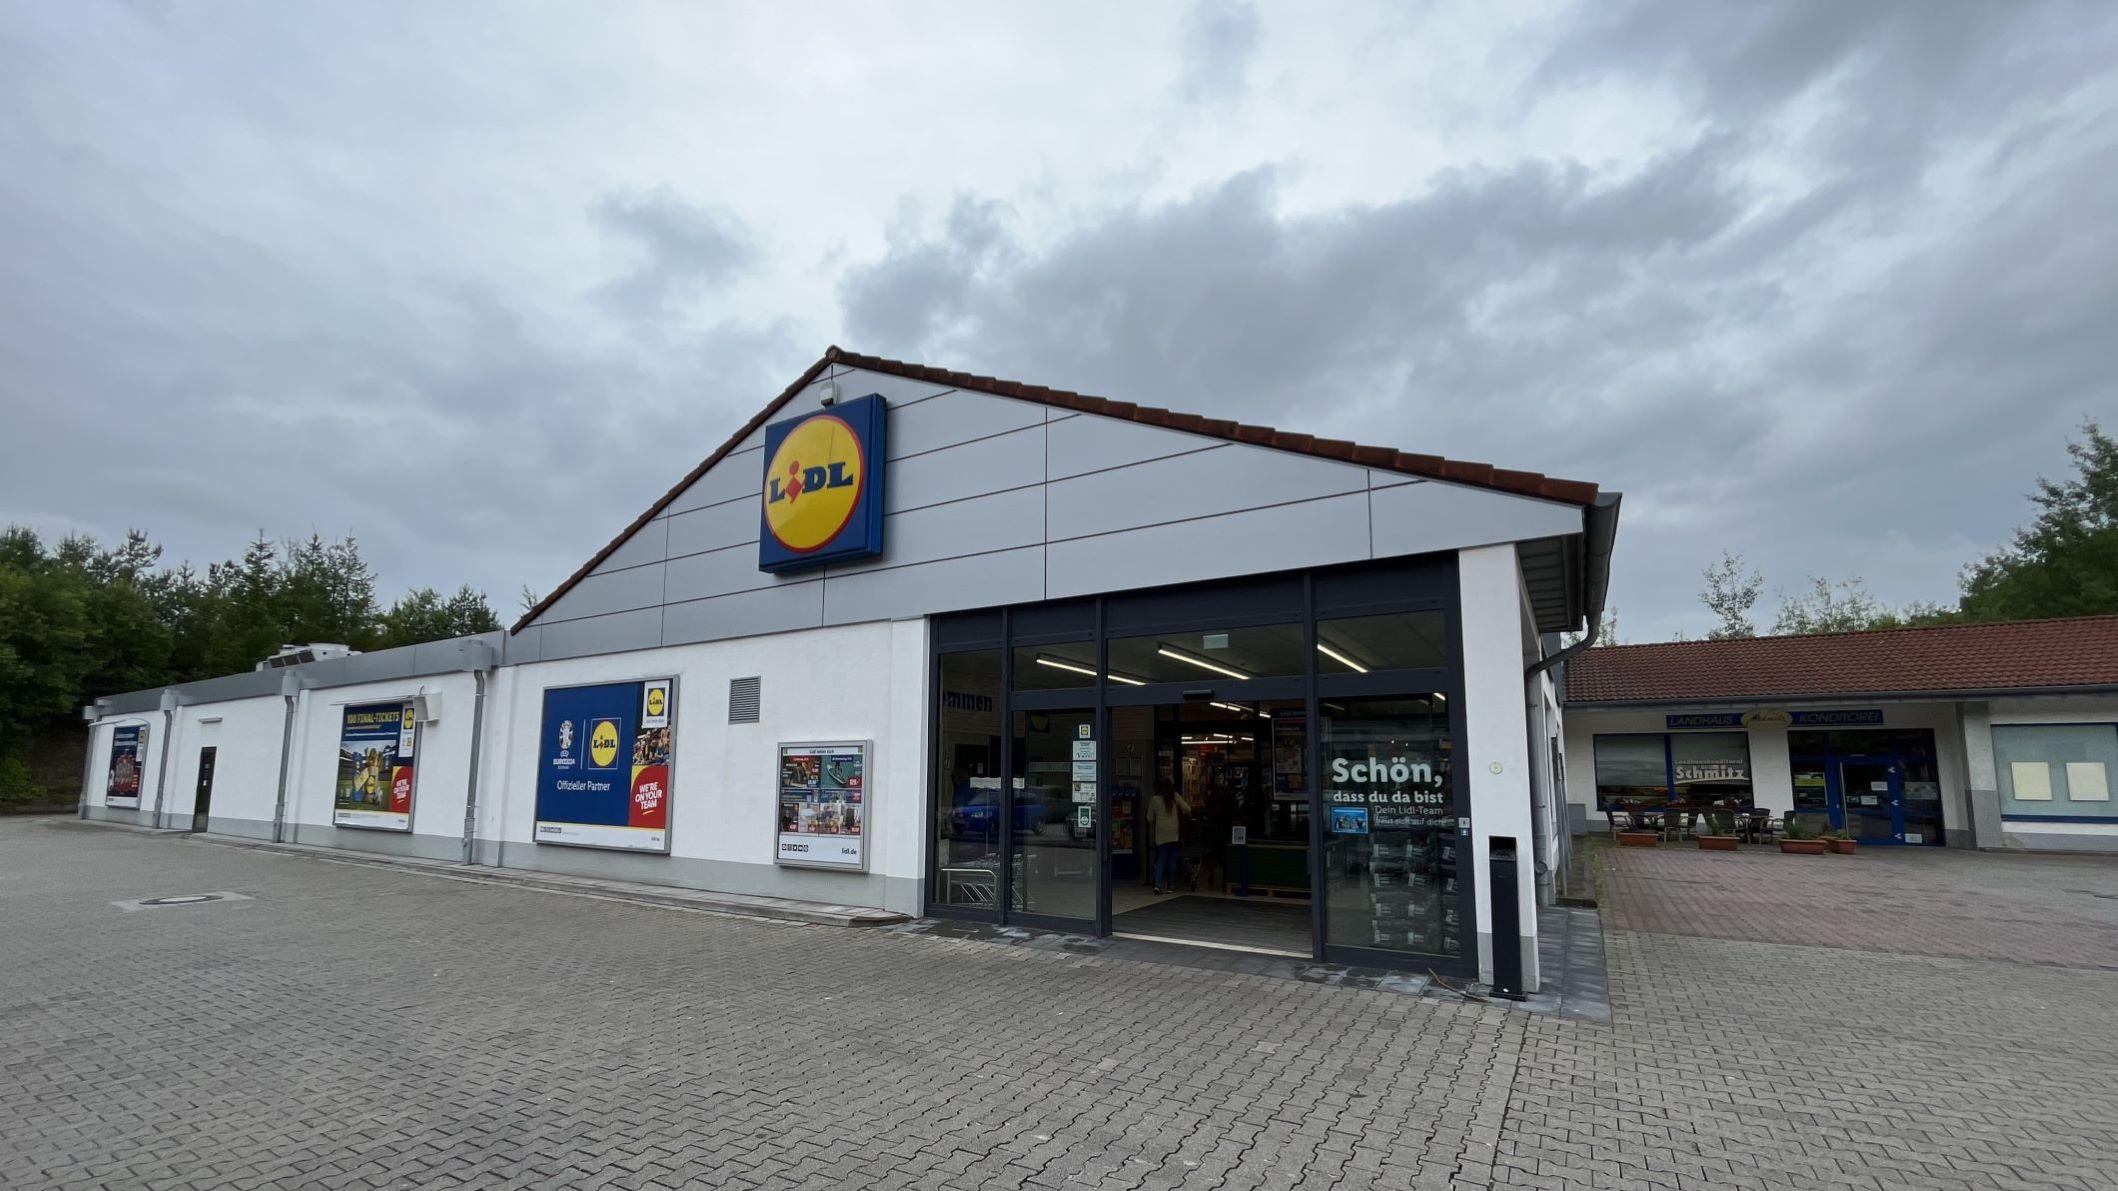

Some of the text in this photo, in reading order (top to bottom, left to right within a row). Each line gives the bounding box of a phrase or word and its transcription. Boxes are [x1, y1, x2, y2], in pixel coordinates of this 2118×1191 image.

[768, 460, 854, 504] LIDL
[1670, 714, 1733, 726] LANDHAUS
[1799, 711, 1882, 724] KONDITOREI
[1331, 756, 1443, 787] Schön,
[1676, 764, 1745, 779] Schmitz
[556, 780, 610, 791] Offizieller Partner
[639, 781, 658, 793] WE'RE
[635, 790, 662, 803] ON YOUR
[1333, 790, 1444, 803] dass du da bist
[640, 799, 658, 810] TEAM
[1374, 805, 1444, 816] Dein Lidl-Team
[841, 847, 857, 855] lidl.de
